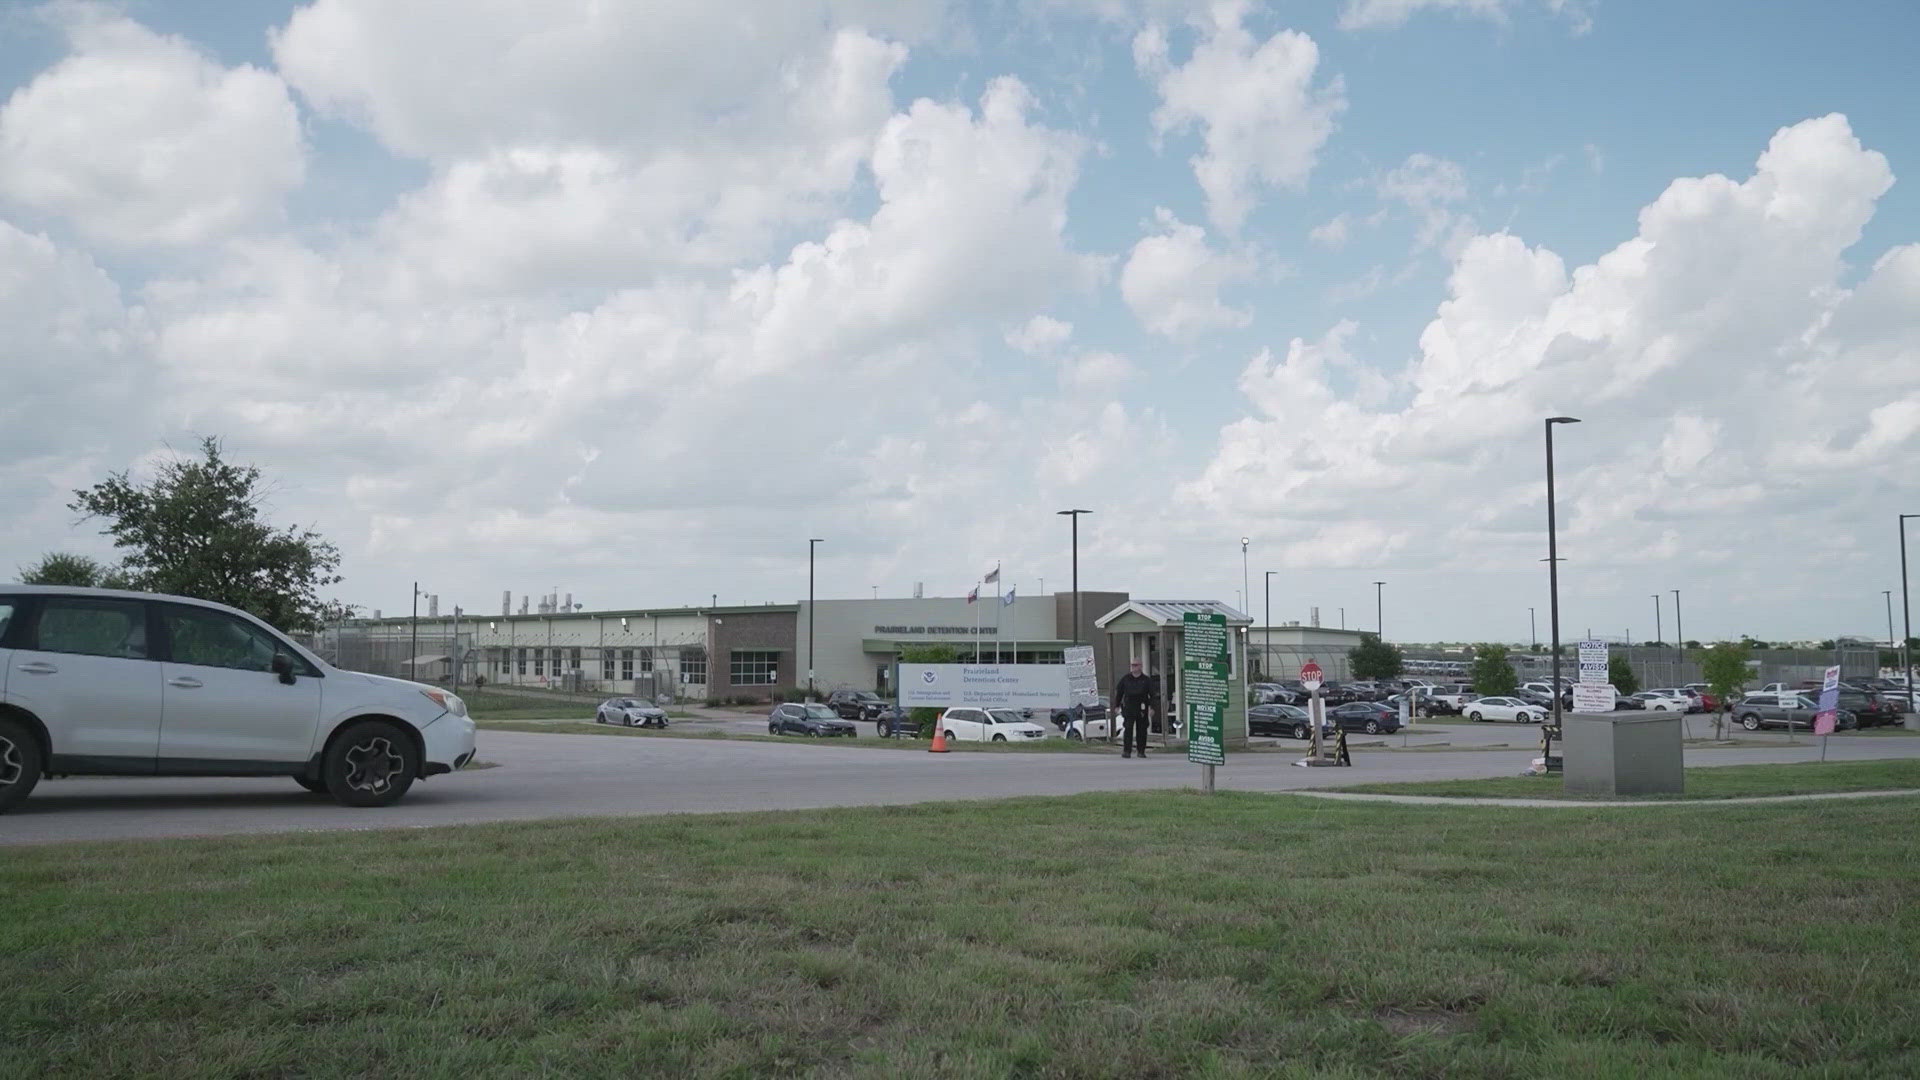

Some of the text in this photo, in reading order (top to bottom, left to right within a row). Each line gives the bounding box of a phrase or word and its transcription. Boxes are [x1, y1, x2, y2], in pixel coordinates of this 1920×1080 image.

[875, 625, 925, 634] PRAIRIELAND
[927, 626, 968, 634] DETENTION
[1198, 662, 1213, 670] STOP
[1583, 663, 1606, 671] AVISO
[1302, 670, 1322, 682] STOP
[1198, 735, 1215, 743] AVISO
